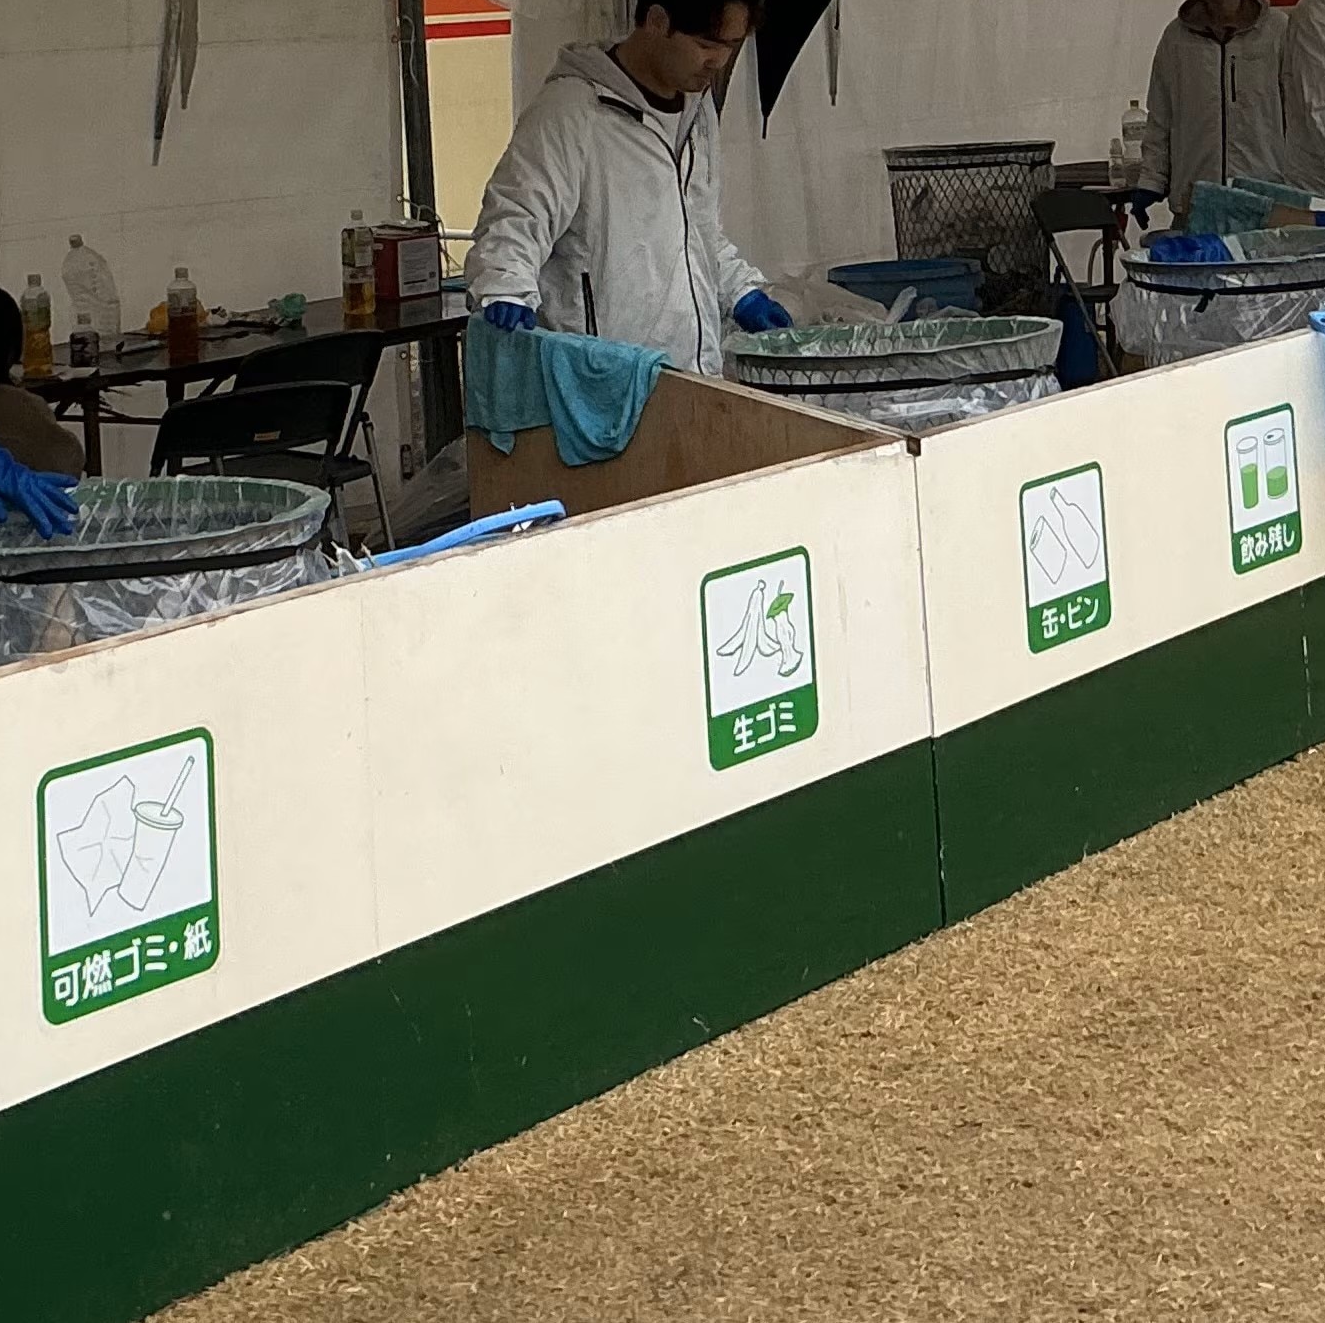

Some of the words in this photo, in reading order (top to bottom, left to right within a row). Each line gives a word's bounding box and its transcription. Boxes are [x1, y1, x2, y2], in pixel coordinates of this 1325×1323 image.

[1239, 522, 1296, 565] 飲み残し
[733, 701, 797, 754] 生ゴミ
[51, 916, 213, 1007] 可燃ゴミ・紙
